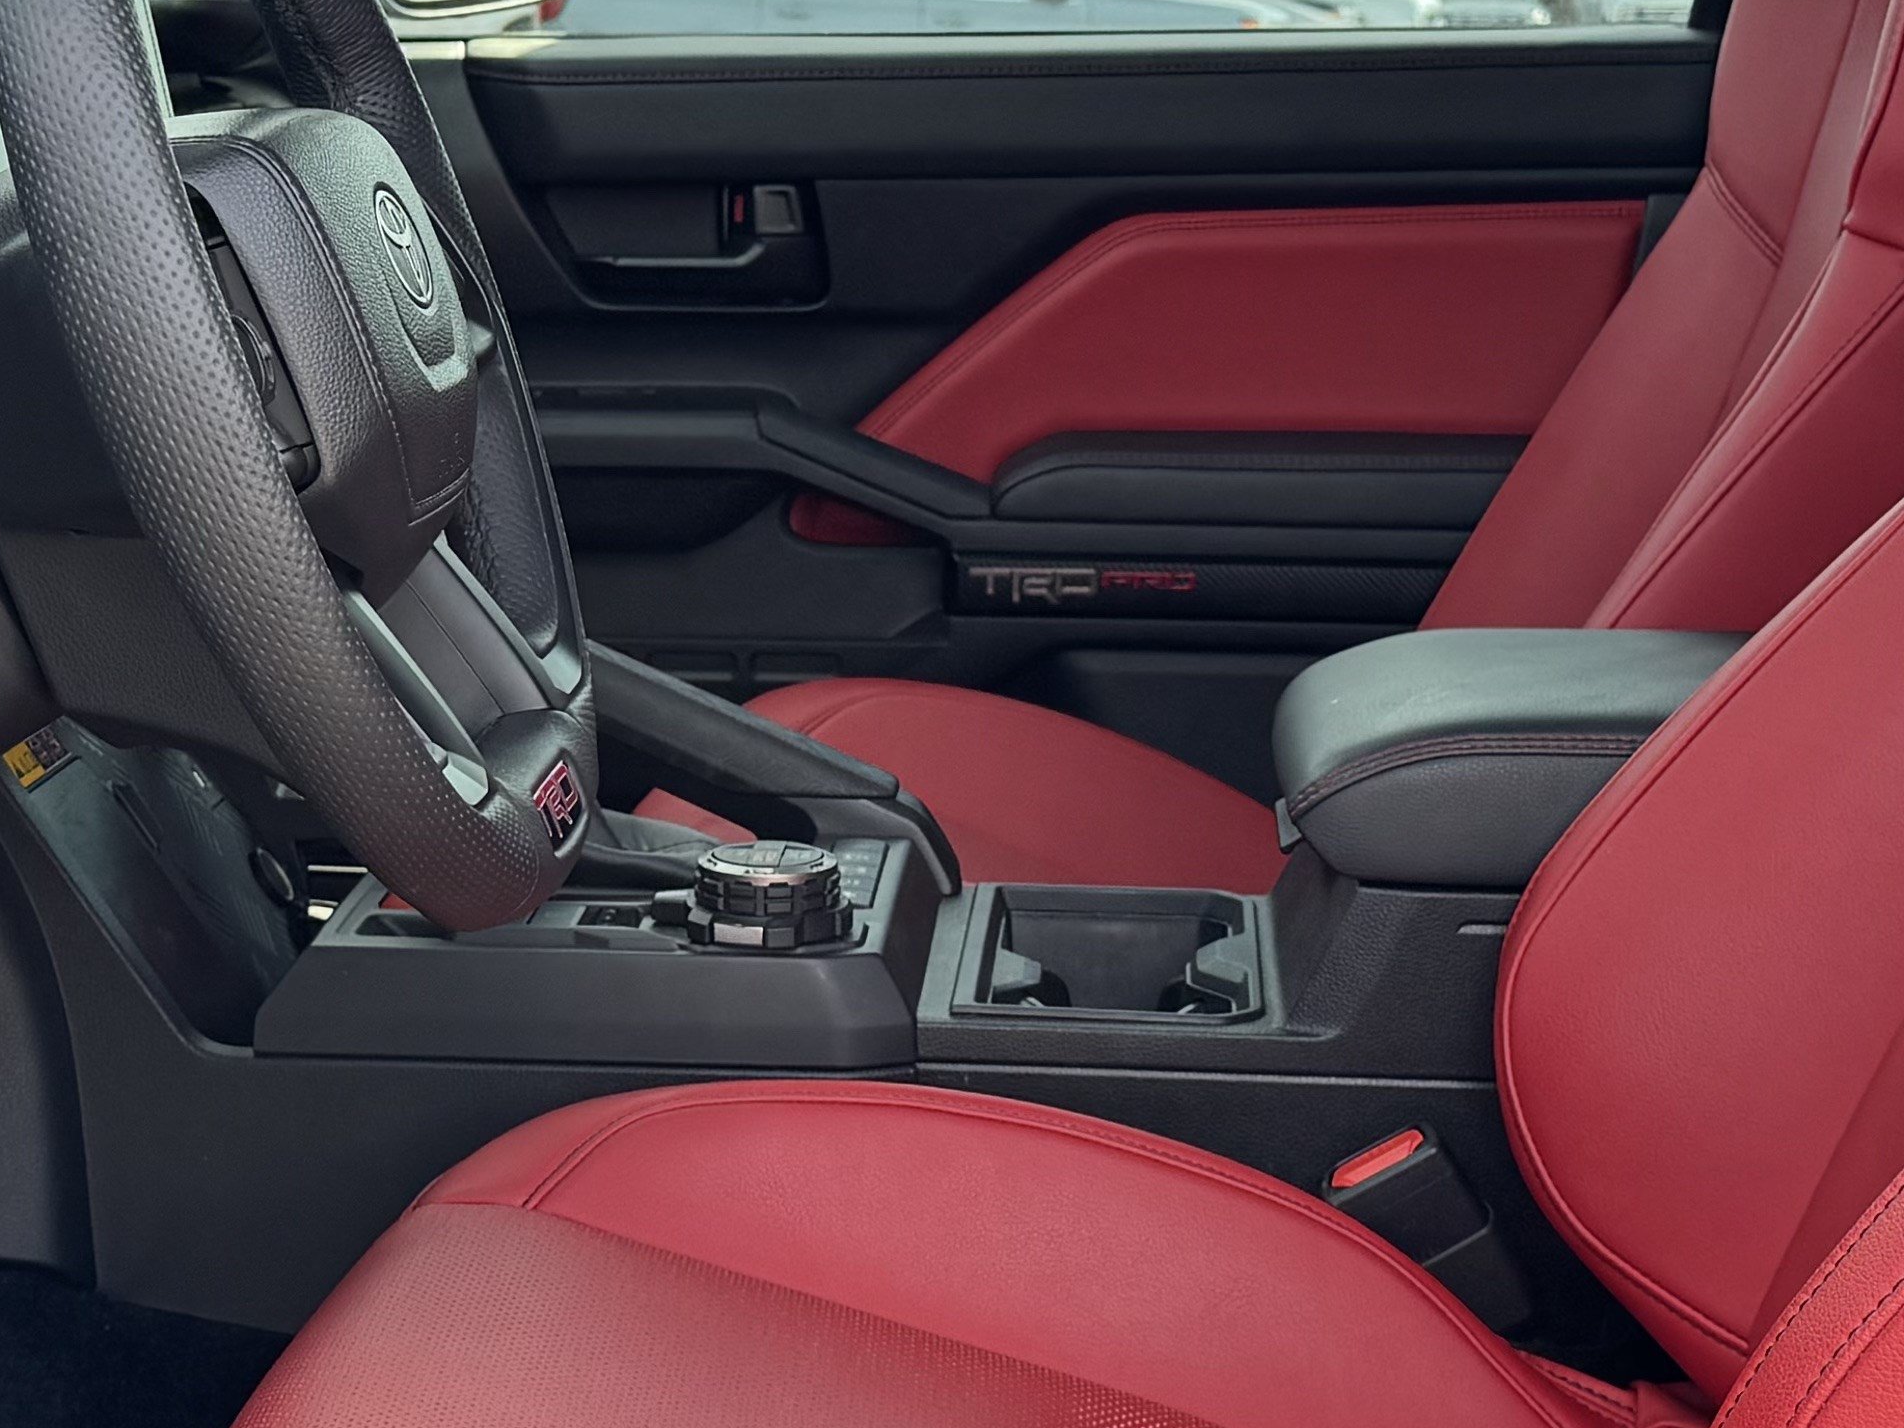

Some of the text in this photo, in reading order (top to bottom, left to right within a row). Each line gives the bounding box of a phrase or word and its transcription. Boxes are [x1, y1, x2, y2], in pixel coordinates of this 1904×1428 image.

[968, 567, 1196, 604] TRD PRO
[533, 760, 578, 838] TRD
